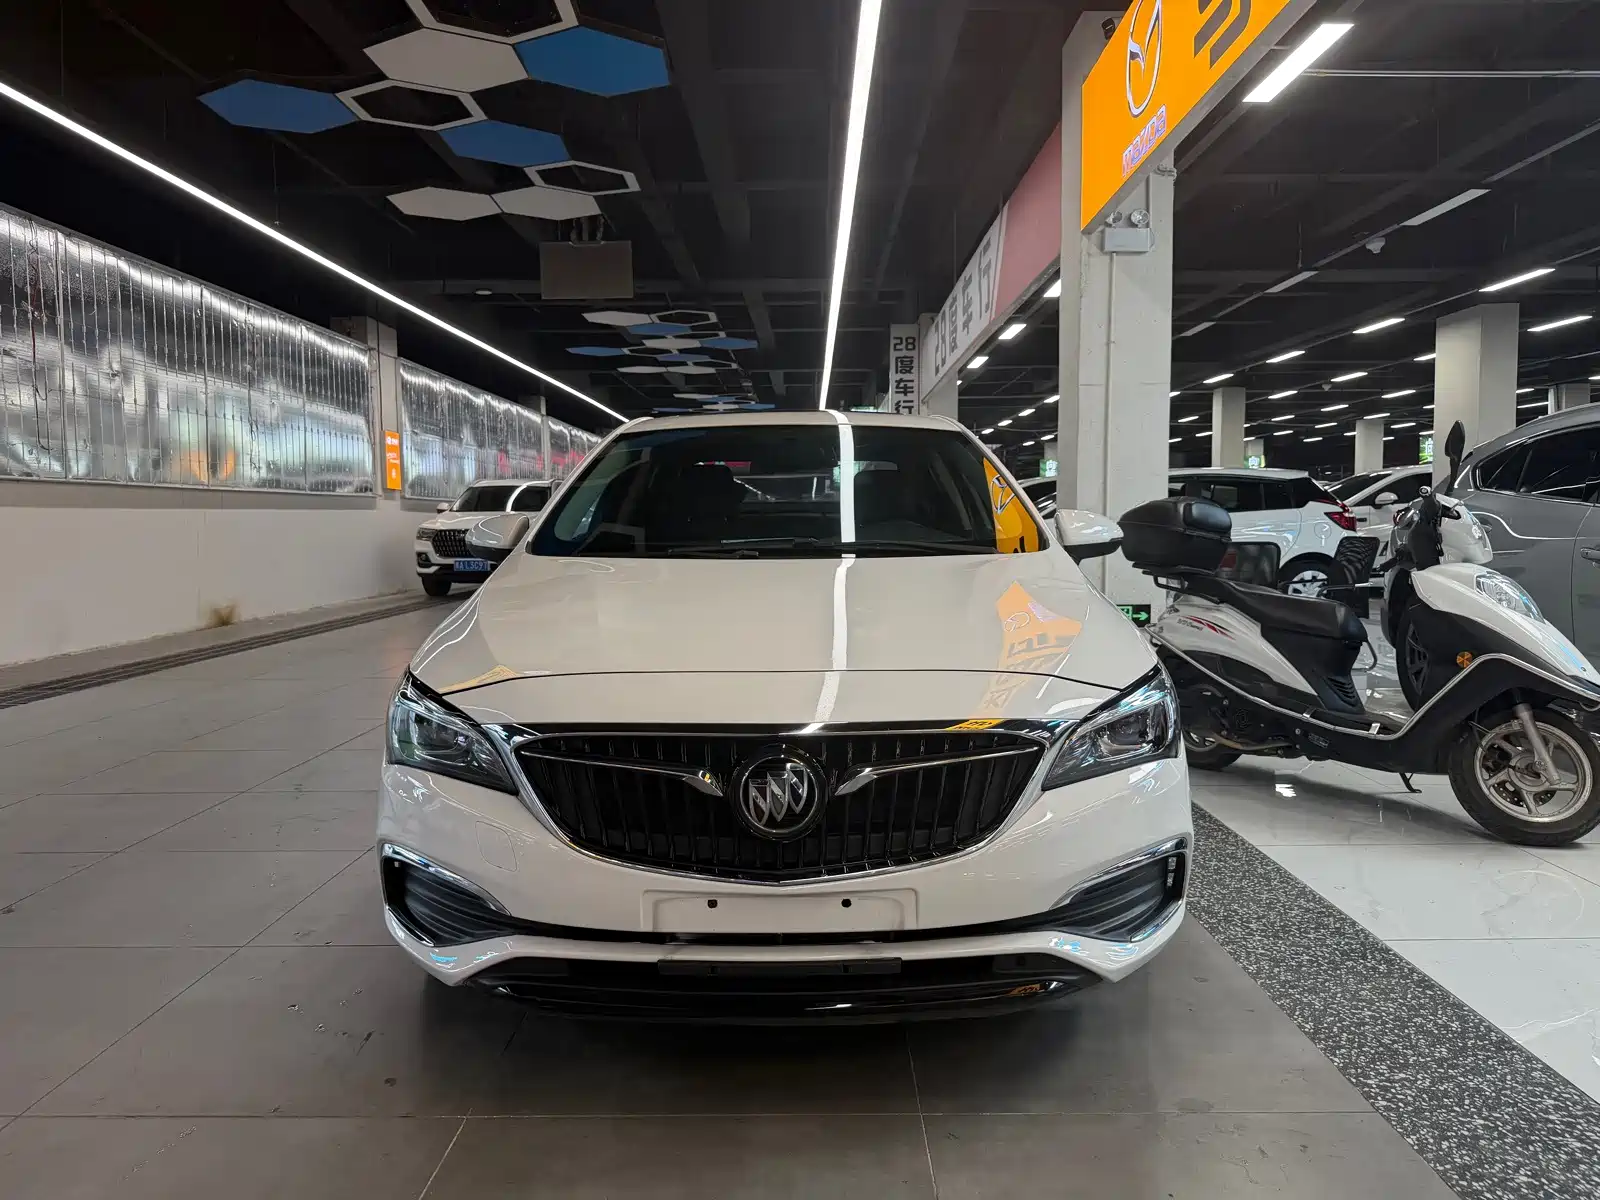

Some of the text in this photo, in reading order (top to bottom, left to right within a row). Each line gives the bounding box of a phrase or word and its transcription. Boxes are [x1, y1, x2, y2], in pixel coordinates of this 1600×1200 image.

[934, 236, 992, 377] 28度车行
[893, 336, 917, 415] 28度车行
